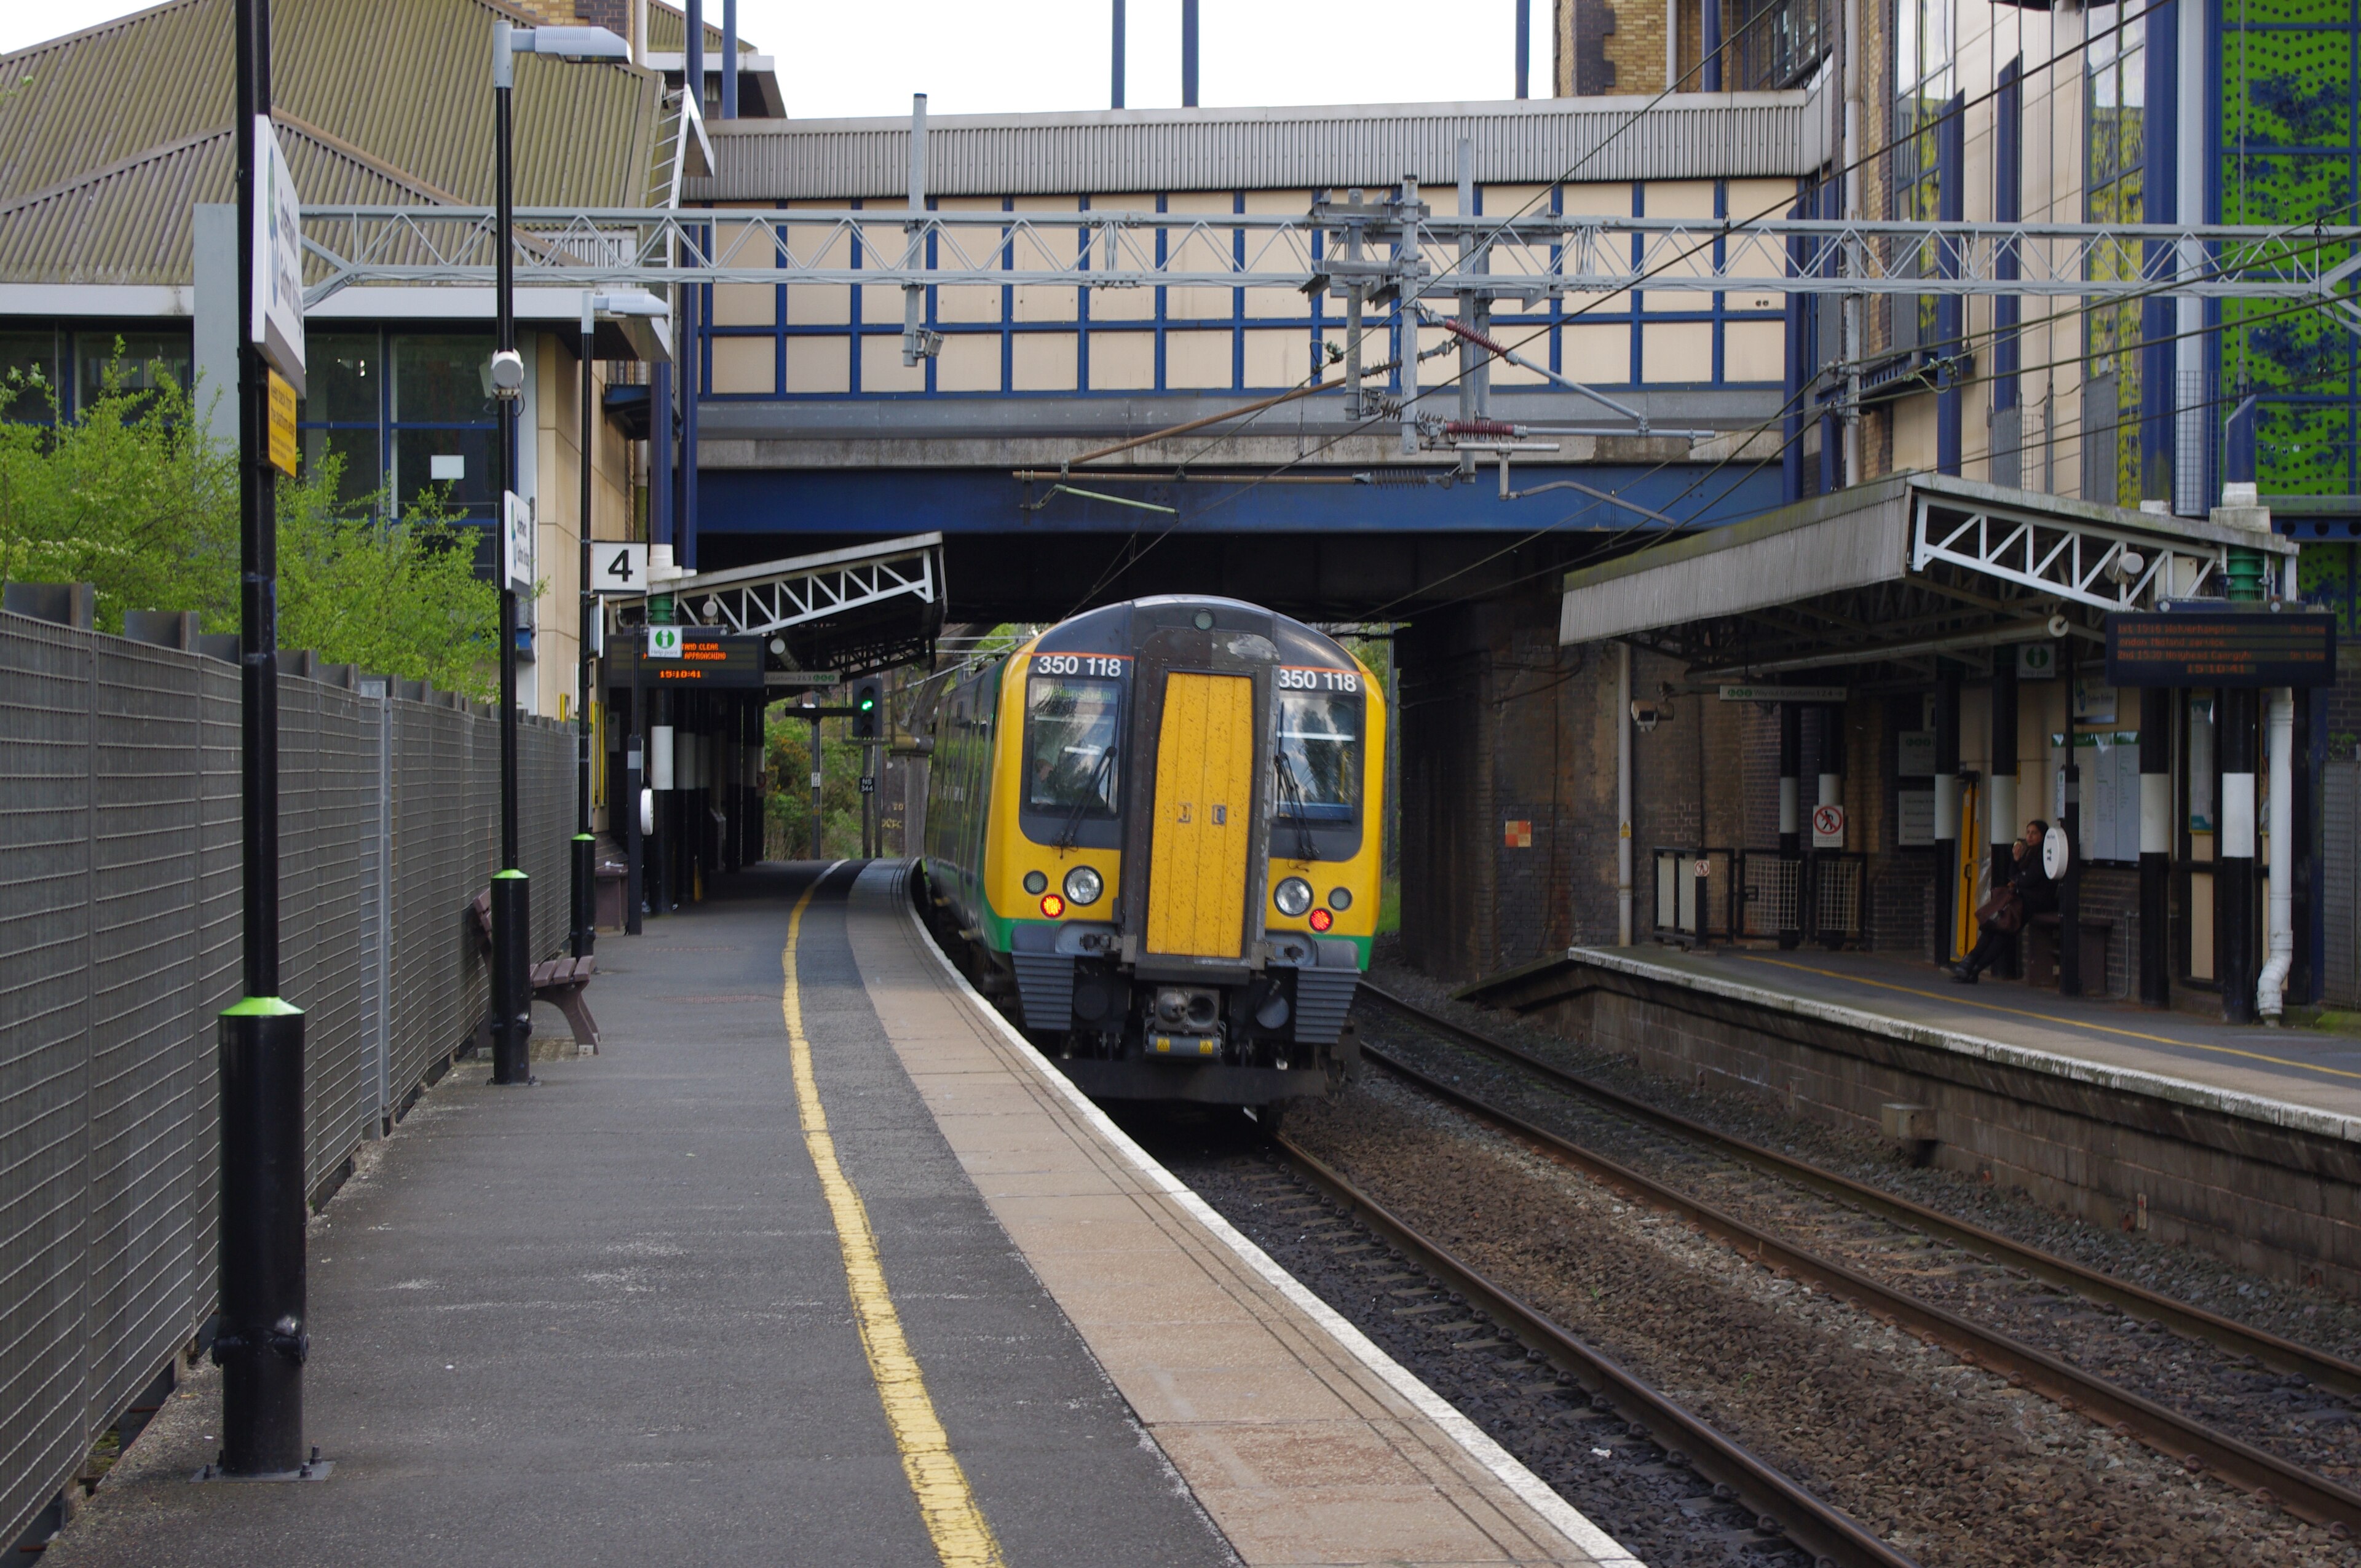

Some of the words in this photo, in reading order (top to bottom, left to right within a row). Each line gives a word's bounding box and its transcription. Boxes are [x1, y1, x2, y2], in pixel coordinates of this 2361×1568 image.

[608, 549, 633, 582] 4
[698, 643, 719, 651] CLEAR
[684, 652, 727, 660] APPROACHING
[1038, 655, 1079, 675] 350
[1086, 657, 1121, 677] 118
[659, 670, 702, 679] 15:10:41
[1278, 669, 1317, 689] 350
[1323, 671, 1357, 693] 118
